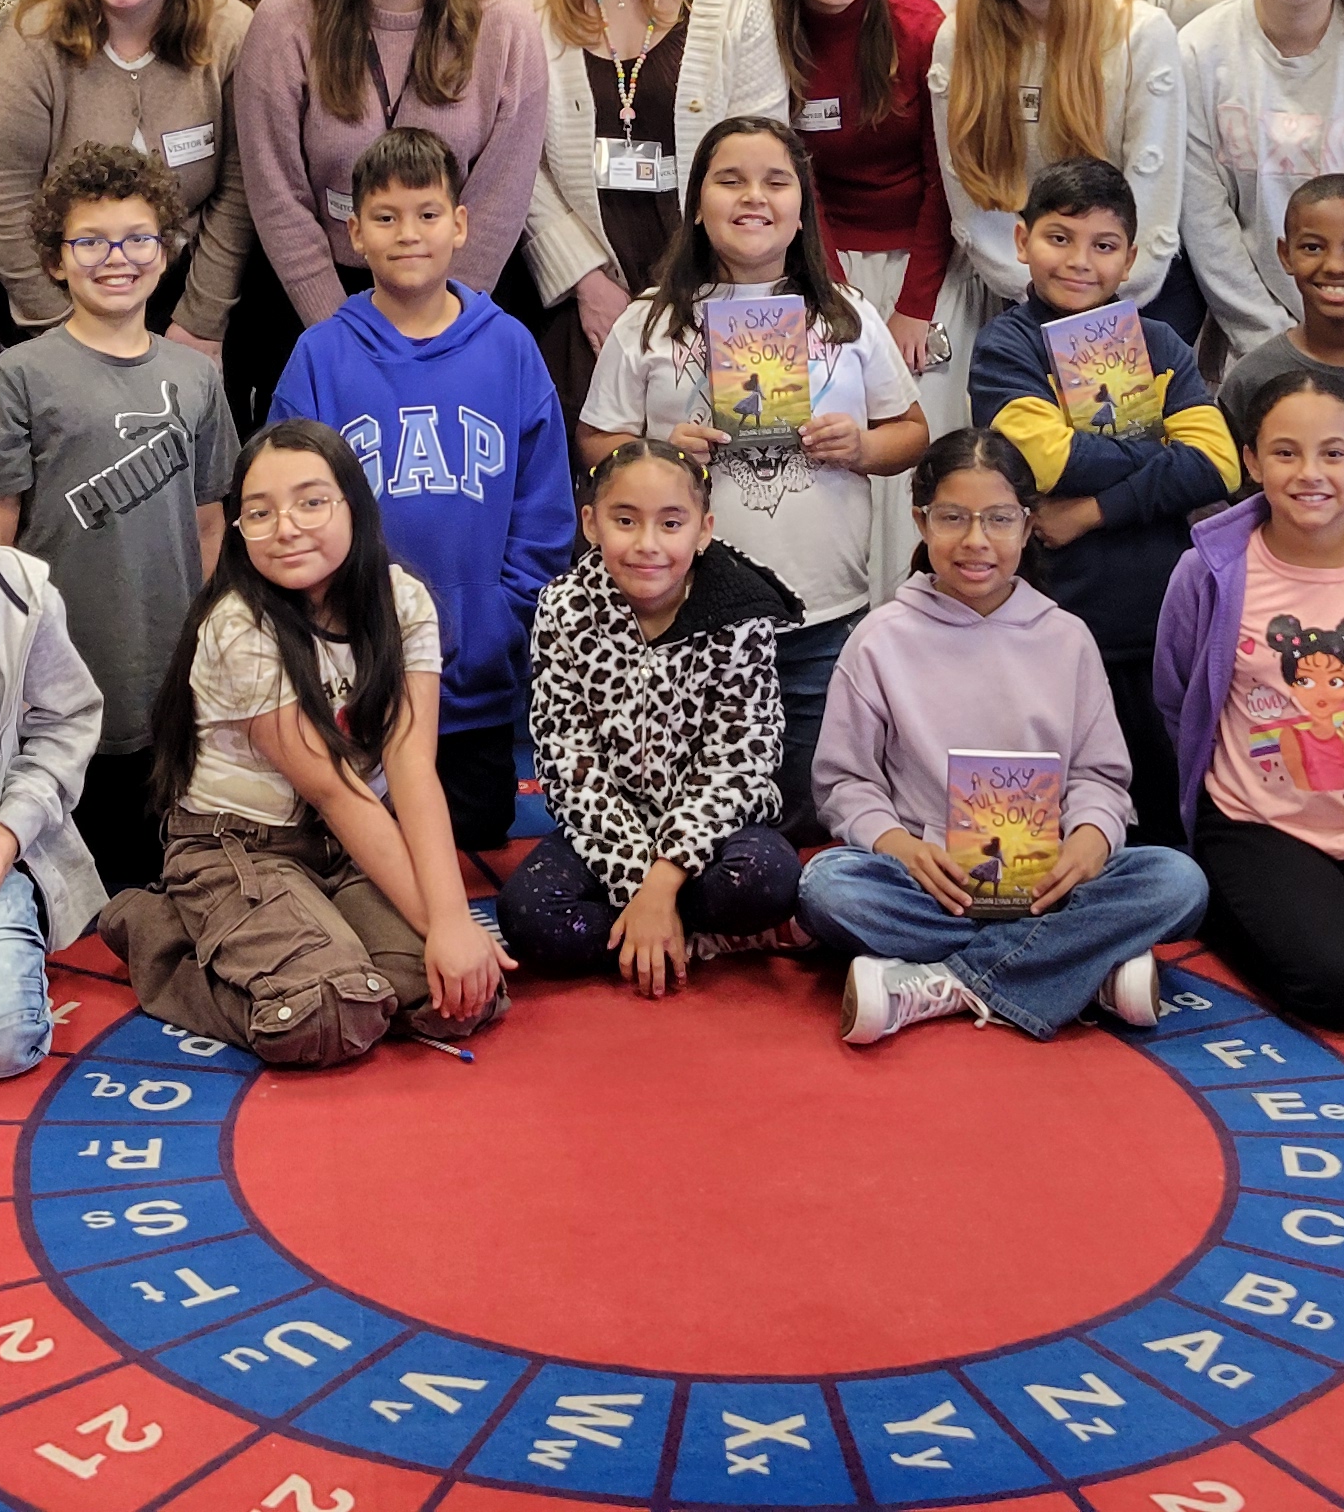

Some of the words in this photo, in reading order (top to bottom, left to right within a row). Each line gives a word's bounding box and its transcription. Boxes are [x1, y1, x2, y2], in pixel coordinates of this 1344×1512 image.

[167, 139, 202, 153] VISITOR
[744, 307, 784, 331] SKY
[1084, 315, 1118, 342] SKY
[723, 332, 757, 354] FULL
[748, 344, 798, 371] SONG
[1069, 345, 1099, 370] FULL
[1092, 348, 1137, 375] SONG
[340, 405, 506, 503] GAP
[65, 430, 189, 530] PUMA
[989, 766, 1035, 790] SKY
[963, 792, 1003, 814] FULL
[991, 806, 1047, 837] SONG
[77, 1138, 163, 1169] Rr
[1221, 1272, 1337, 1331] Bb
[1143, 1329, 1256, 1390] Aa
[34, 1403, 164, 1480] 21
